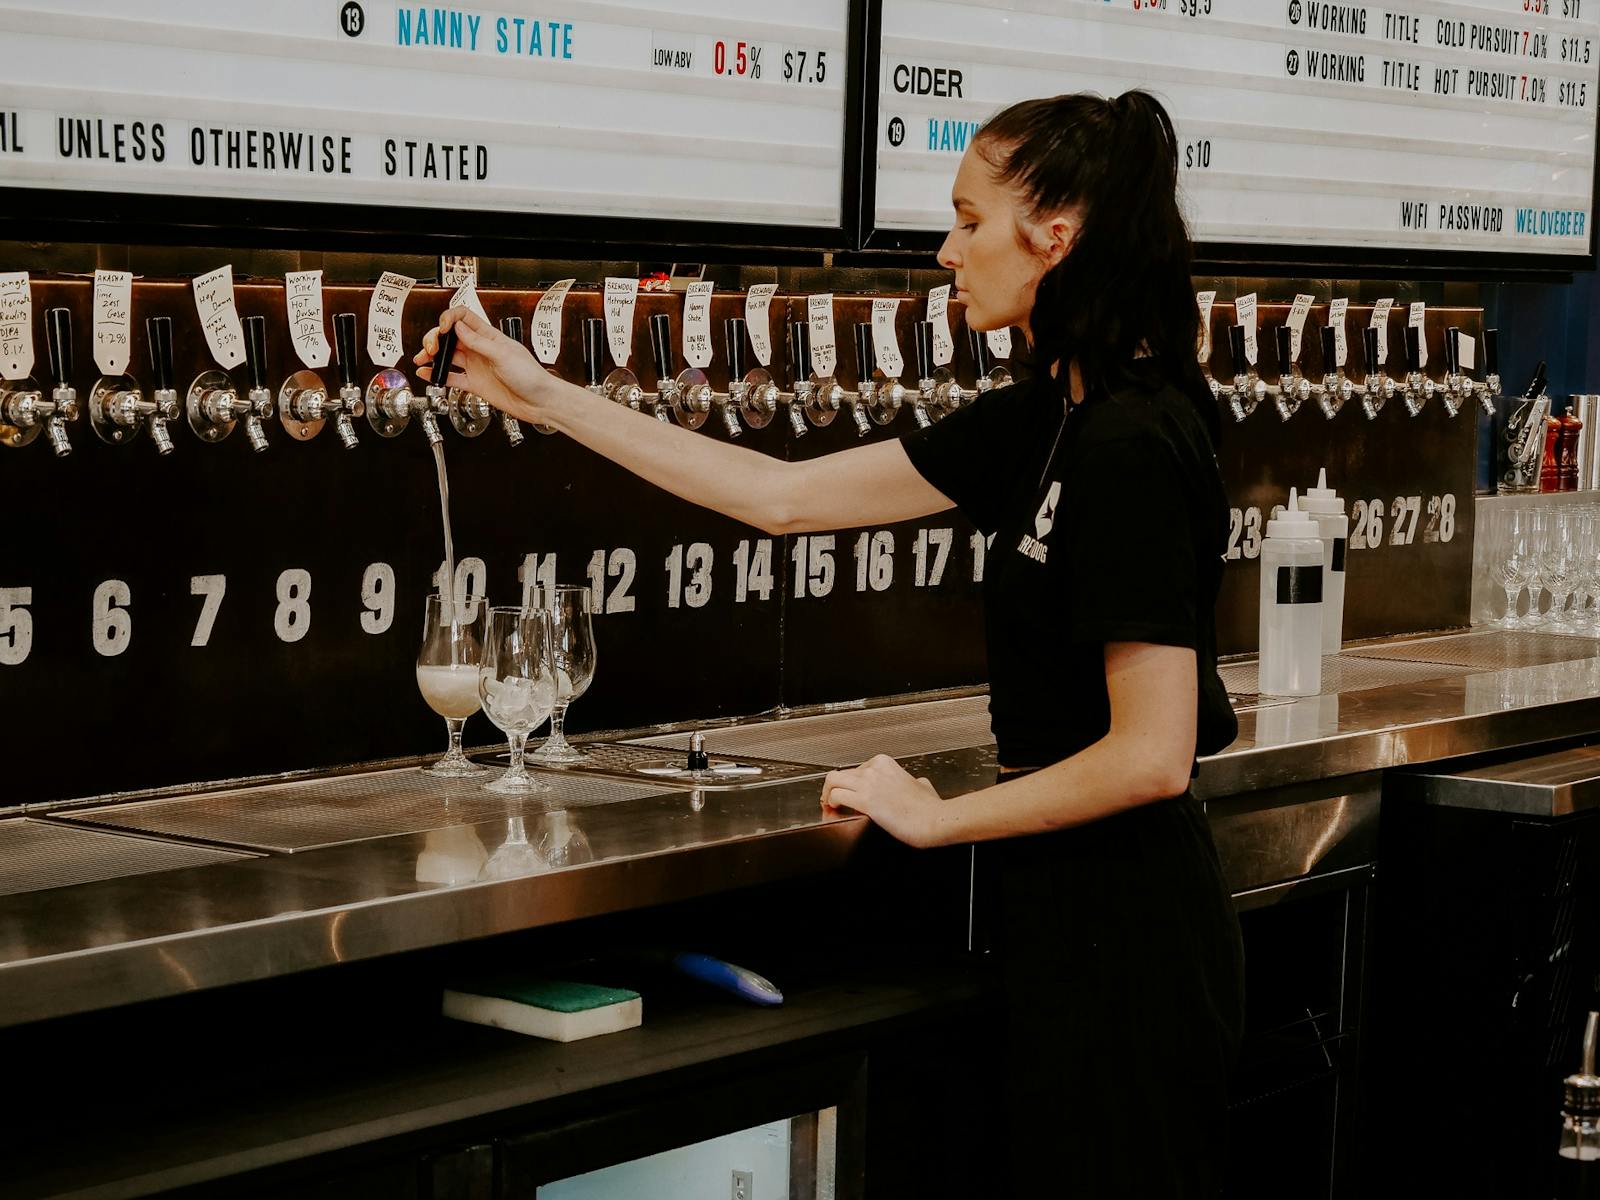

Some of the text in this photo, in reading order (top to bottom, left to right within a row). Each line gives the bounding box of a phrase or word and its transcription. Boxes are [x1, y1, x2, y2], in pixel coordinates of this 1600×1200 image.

[343, 5, 826, 83] 13 NANNY STATE LOW ABV 0.5% $7.5
[1289, 1, 1591, 64] 26 WORKING TITLE COLD PURSUIT 7.0% $11.5
[893, 64, 963, 98] CIDER
[1287, 50, 1586, 107] 27 WORKING TITLE HOT PURSUIT 7.0% $11.5
[59, 117, 165, 163] UNLESS
[191, 127, 352, 173] OTHERWISE
[385, 139, 488, 181] STATED
[889, 118, 904, 145] 19
[1186, 140, 1211, 168] $10
[1402, 201, 1585, 236] WIFI PASSWORD WELOVEBEER
[1226, 506, 1263, 560] 23
[1349, 499, 1385, 550] 26
[1389, 496, 1422, 546] 27
[1423, 493, 1457, 544] 28
[587, 548, 637, 614] 12
[665, 543, 714, 608] 13
[733, 539, 775, 603] 14
[791, 535, 836, 599] 15
[854, 530, 896, 592] 16
[912, 528, 954, 587] 17
[970, 529, 997, 582] 1
[93, 579, 132, 657] 6
[190, 574, 227, 647] 7
[274, 568, 312, 643] 8
[360, 562, 396, 635] 9
[432, 556, 487, 627] 10
[0, 587, 33, 665] 5
